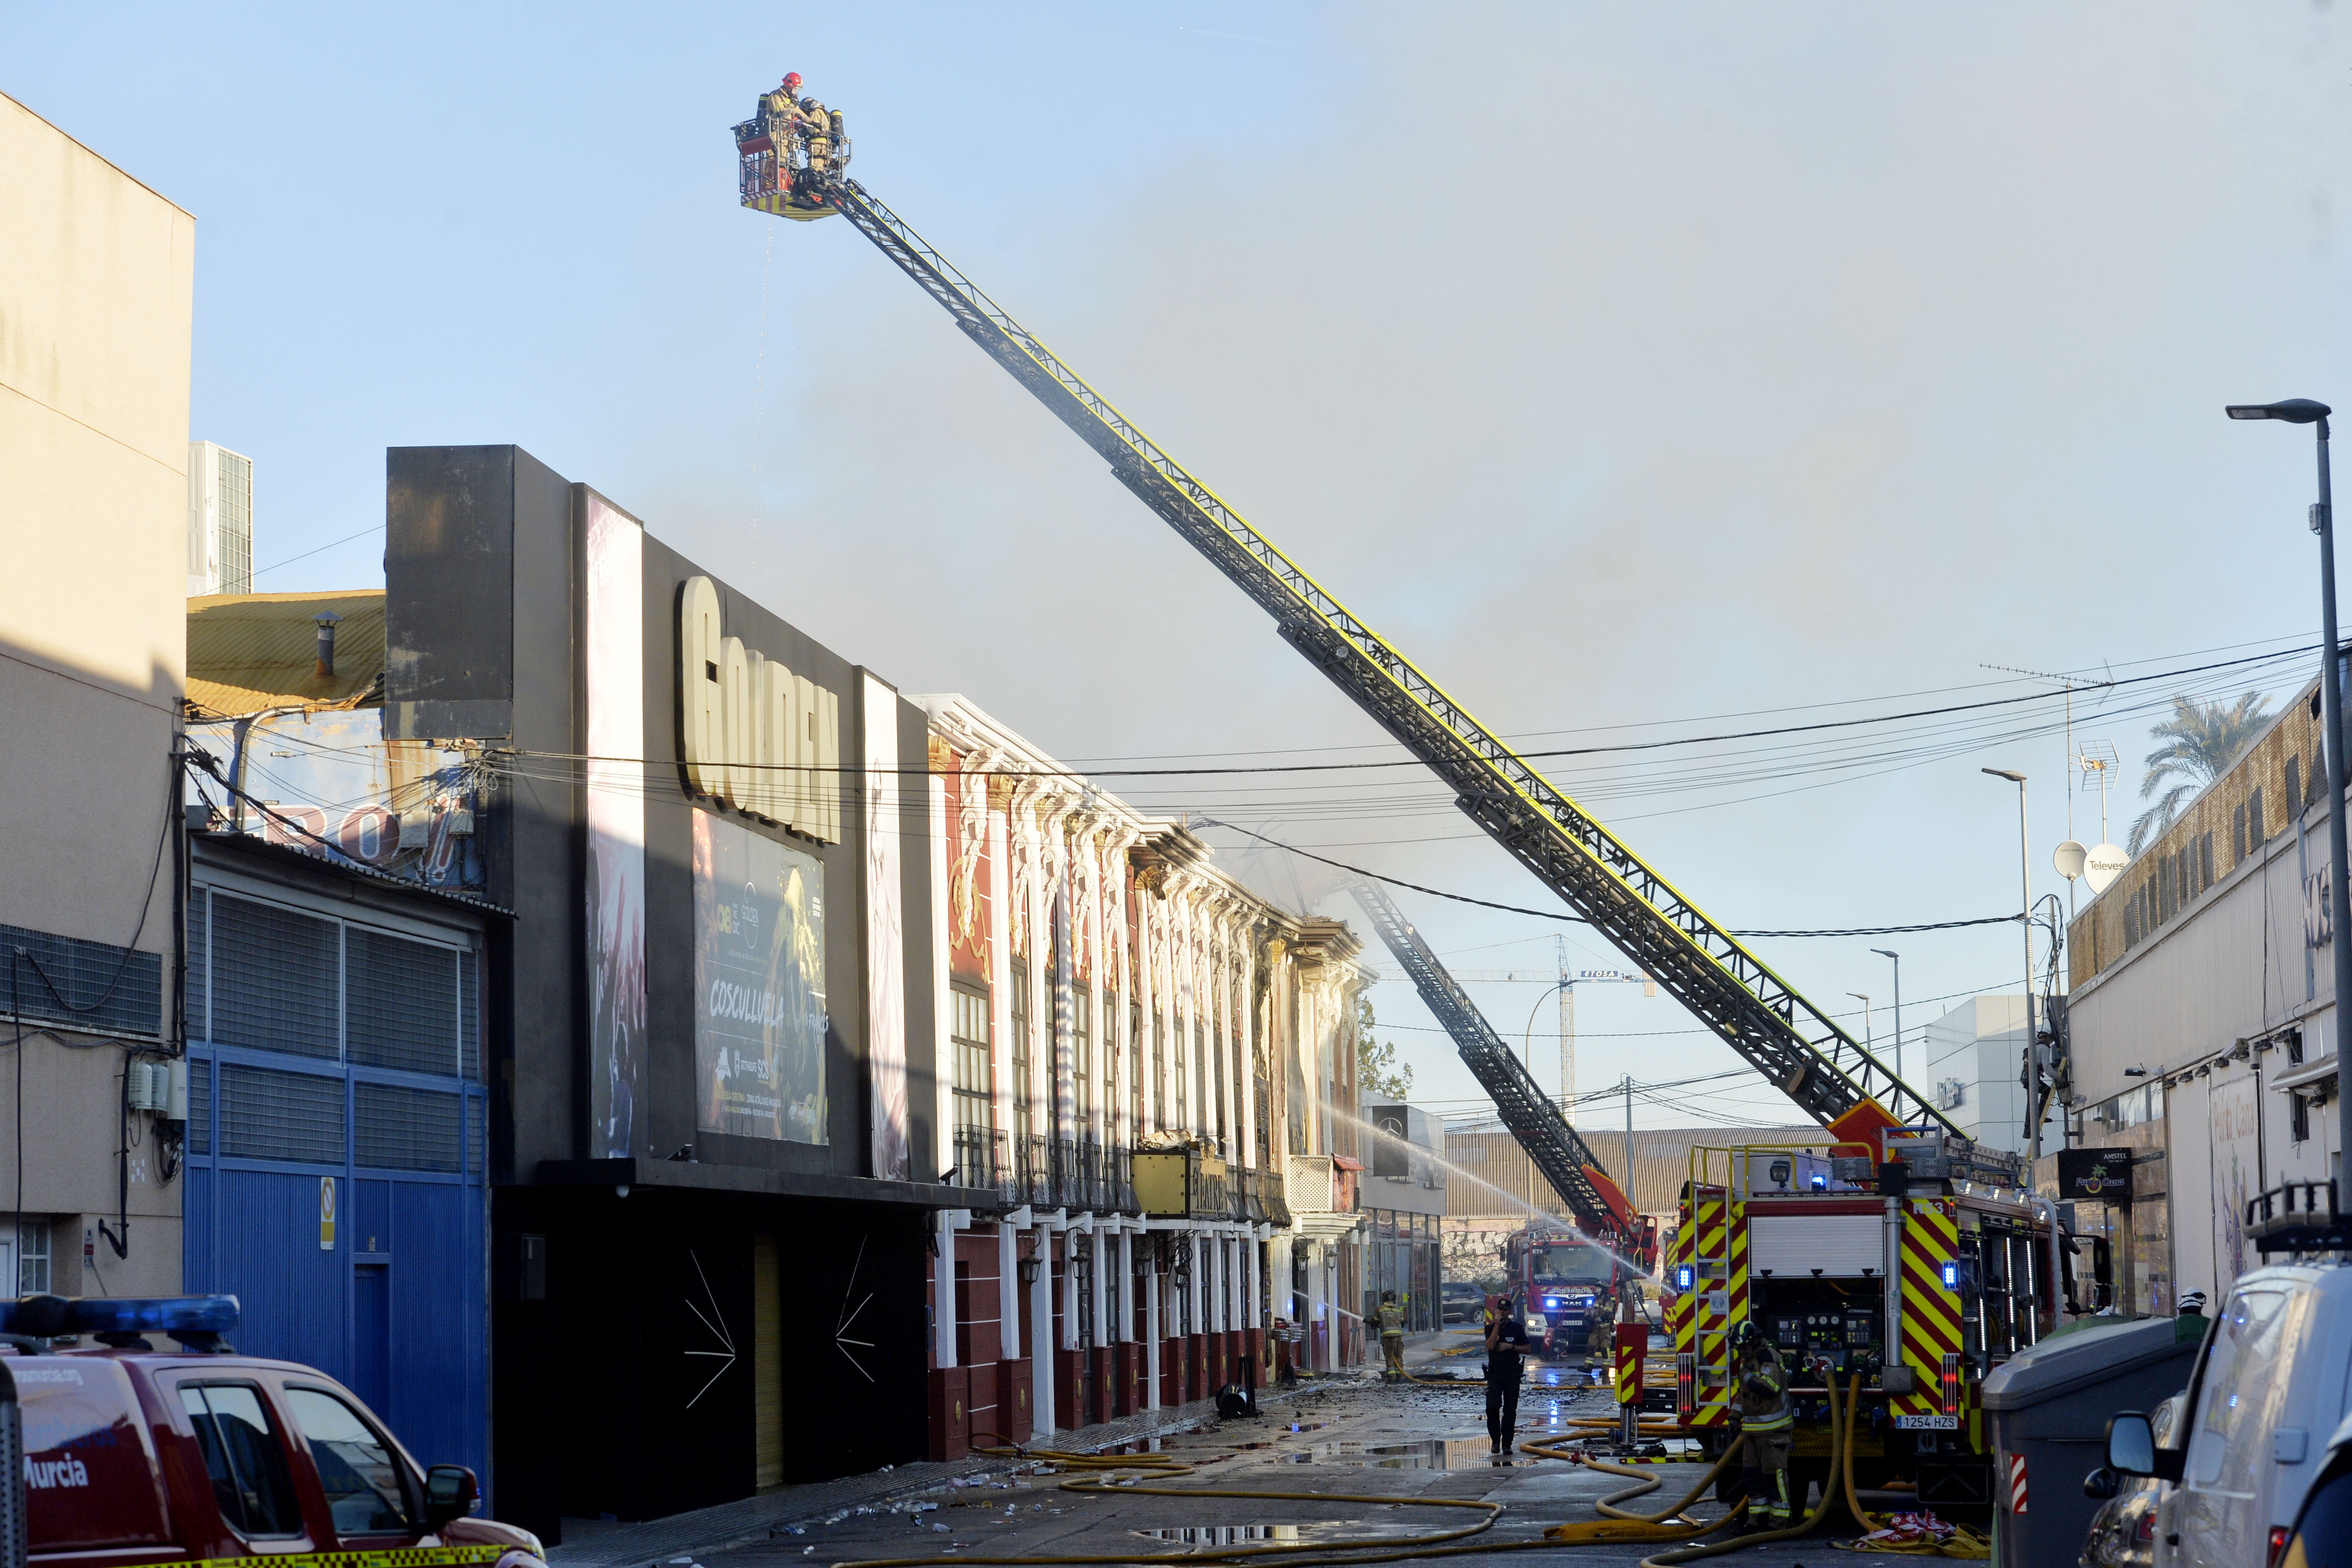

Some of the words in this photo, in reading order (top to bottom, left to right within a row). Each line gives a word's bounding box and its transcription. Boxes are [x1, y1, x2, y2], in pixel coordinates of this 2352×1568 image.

[682, 576, 840, 845] GOLDEN
[2089, 860, 2125, 870] Televes
[717, 904, 732, 934] 08
[742, 905, 758, 924] GOLDEN
[710, 977, 785, 1030] COSCULLUELA
[758, 1059, 769, 1080] SCS
[2102, 1177, 2125, 1187] Cana
[1913, 1202, 1944, 1214] R53
[1905, 1417, 1930, 1427] 1254
[1935, 1417, 1955, 1427] HZS
[24, 1452, 89, 1489] Murcia
